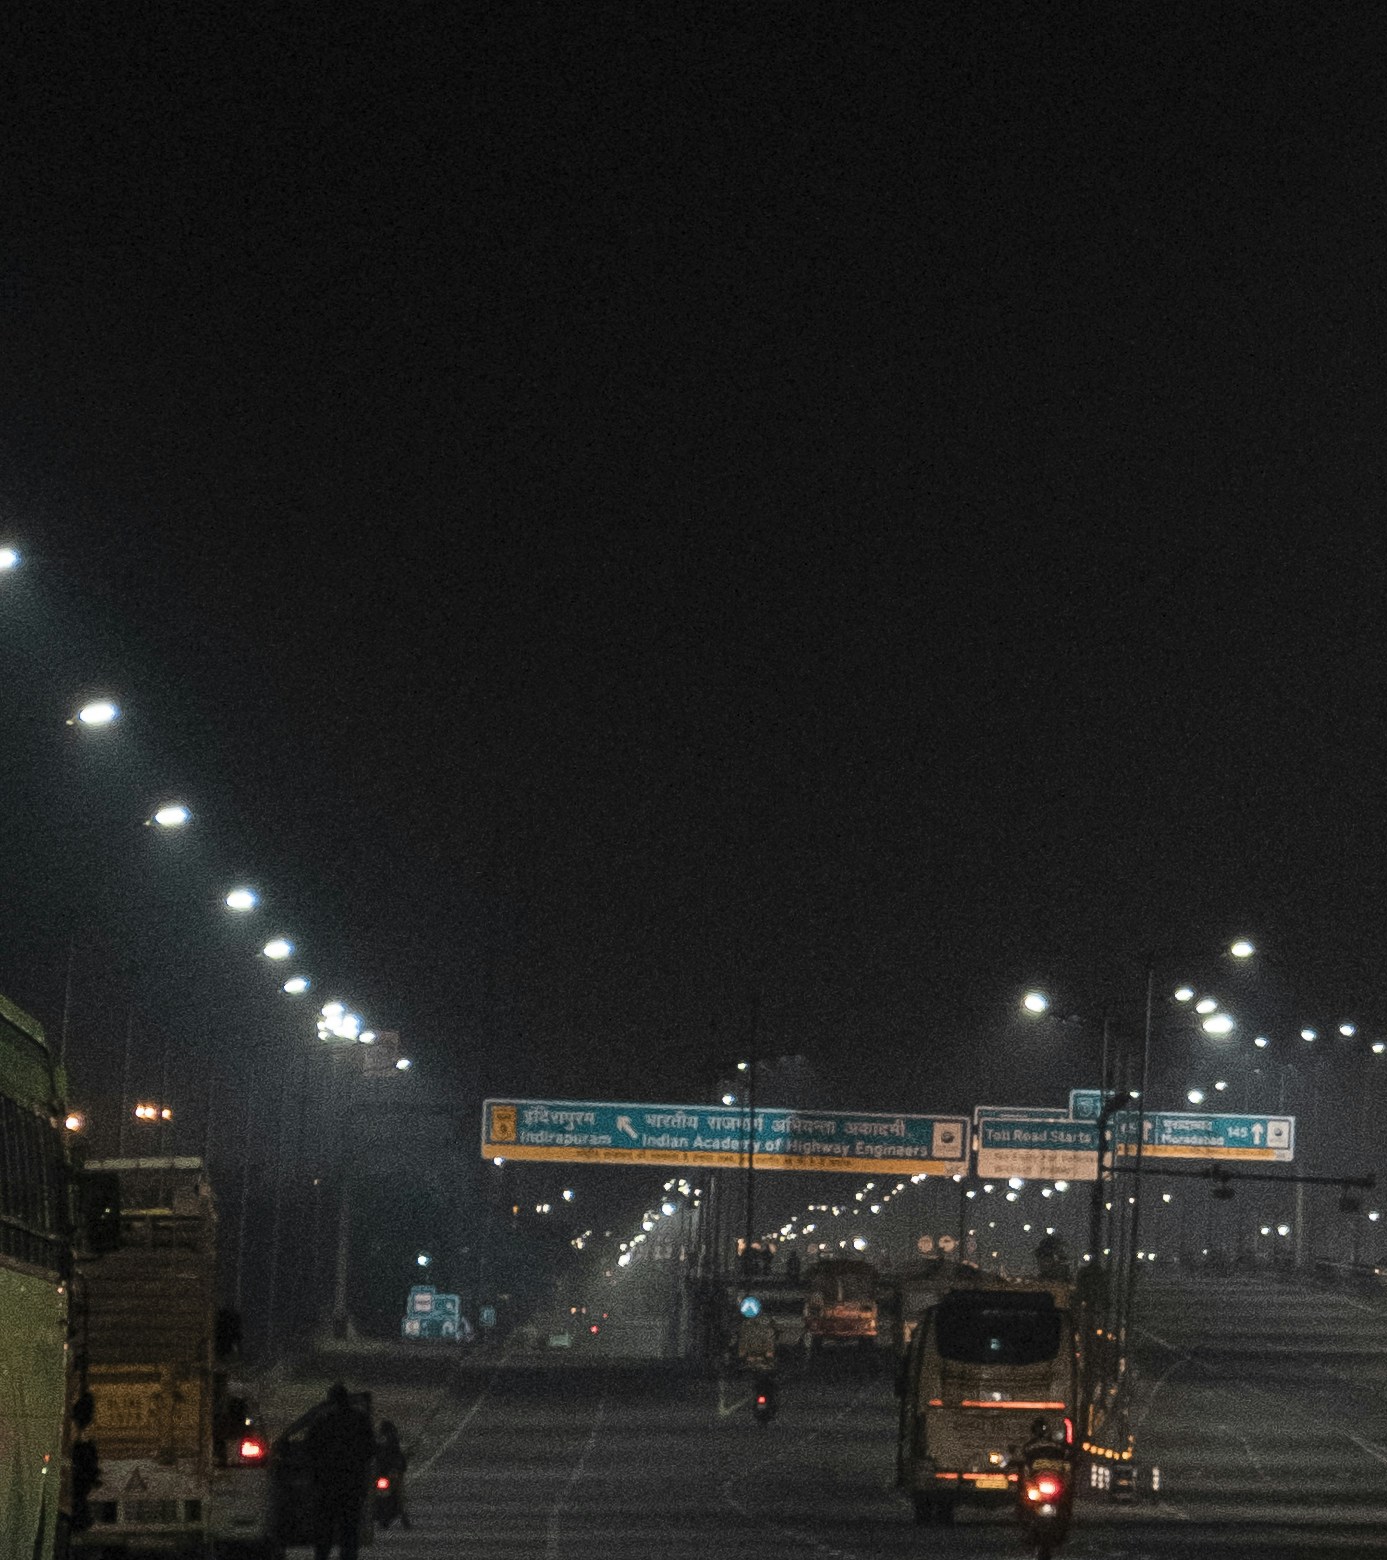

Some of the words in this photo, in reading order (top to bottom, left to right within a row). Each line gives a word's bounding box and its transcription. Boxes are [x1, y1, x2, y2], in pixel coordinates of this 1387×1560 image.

[986, 1130, 1011, 1141] Toll
[1013, 1130, 1048, 1142] Road
[1050, 1131, 1093, 1143] Starts
[641, 1134, 689, 1149] Indian
[764, 1137, 783, 1152] of
[786, 1140, 850, 1157] Highway
[855, 1142, 929, 1159] Engineers
